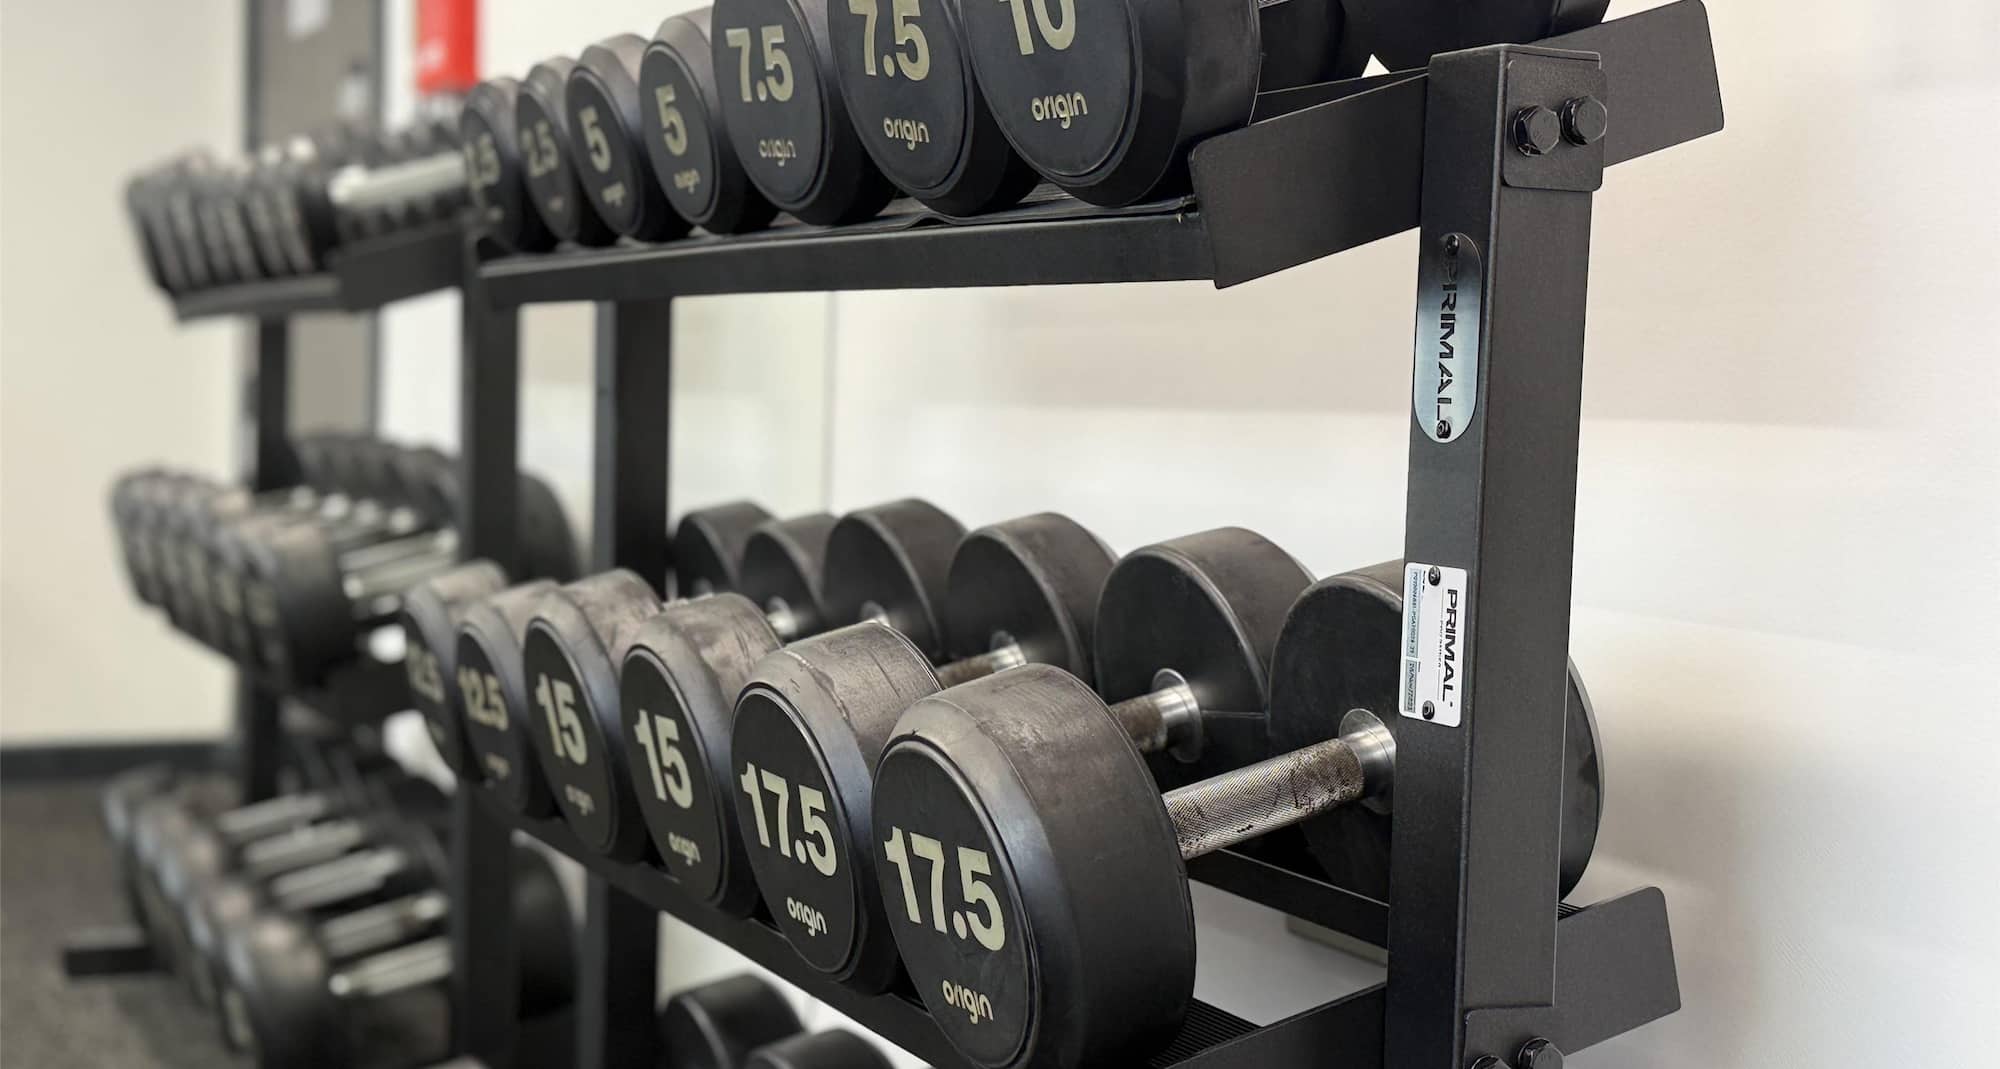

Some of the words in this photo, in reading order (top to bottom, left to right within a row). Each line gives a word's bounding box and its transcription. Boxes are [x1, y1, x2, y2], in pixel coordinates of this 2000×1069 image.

[848, 0, 931, 81] 7.5
[1002, 0, 1077, 55] 10
[725, 25, 795, 103] 7.5
[579, 105, 612, 173] 5
[655, 84, 689, 156] 5
[883, 117, 930, 151] origin
[1031, 91, 1089, 130] origin
[759, 137, 797, 167] origin
[1442, 588, 1459, 702] PRIMAL
[535, 672, 588, 765] 15
[634, 708, 693, 809] 15
[740, 761, 838, 877] 17.5
[787, 896, 828, 938] origin
[884, 825, 1006, 951] 17.5
[942, 979, 994, 1025] origin
